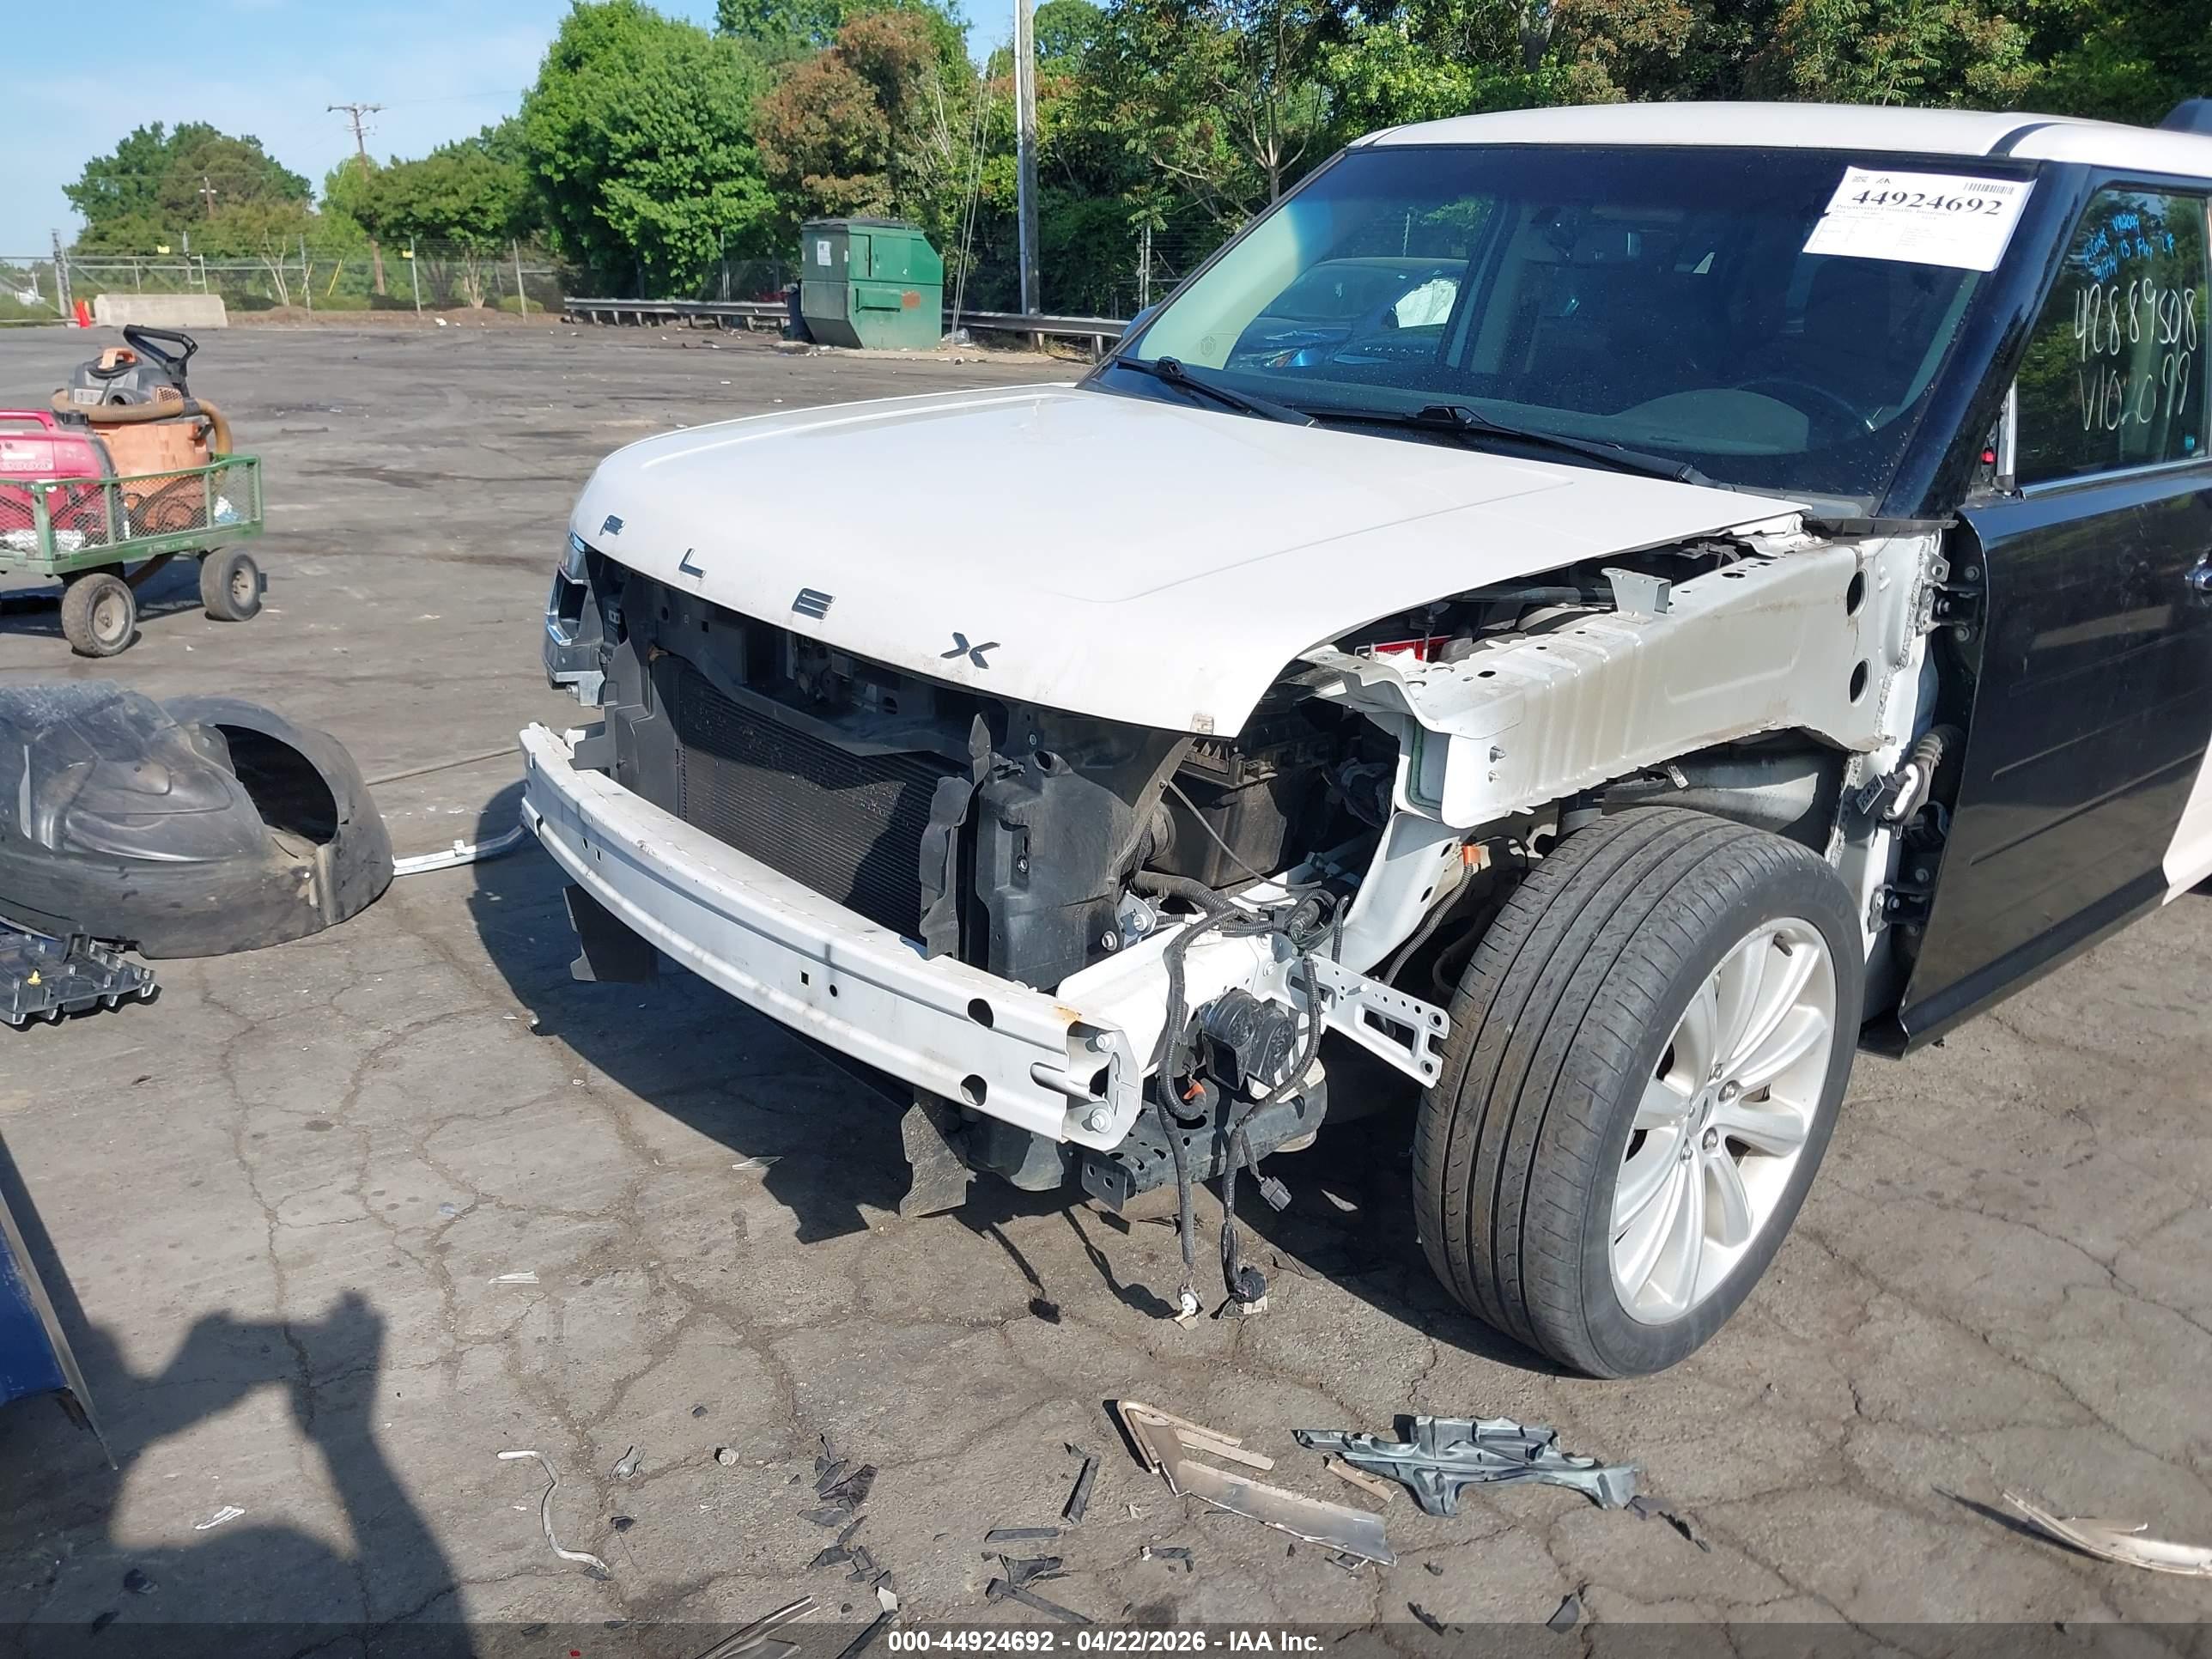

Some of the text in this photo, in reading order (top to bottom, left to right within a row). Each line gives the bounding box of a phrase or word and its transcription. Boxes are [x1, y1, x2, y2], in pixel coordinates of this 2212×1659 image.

[1851, 189, 2003, 216] 44924692
[2075, 277, 2197, 362] 42889508
[599, 514, 1002, 671] FLEX
